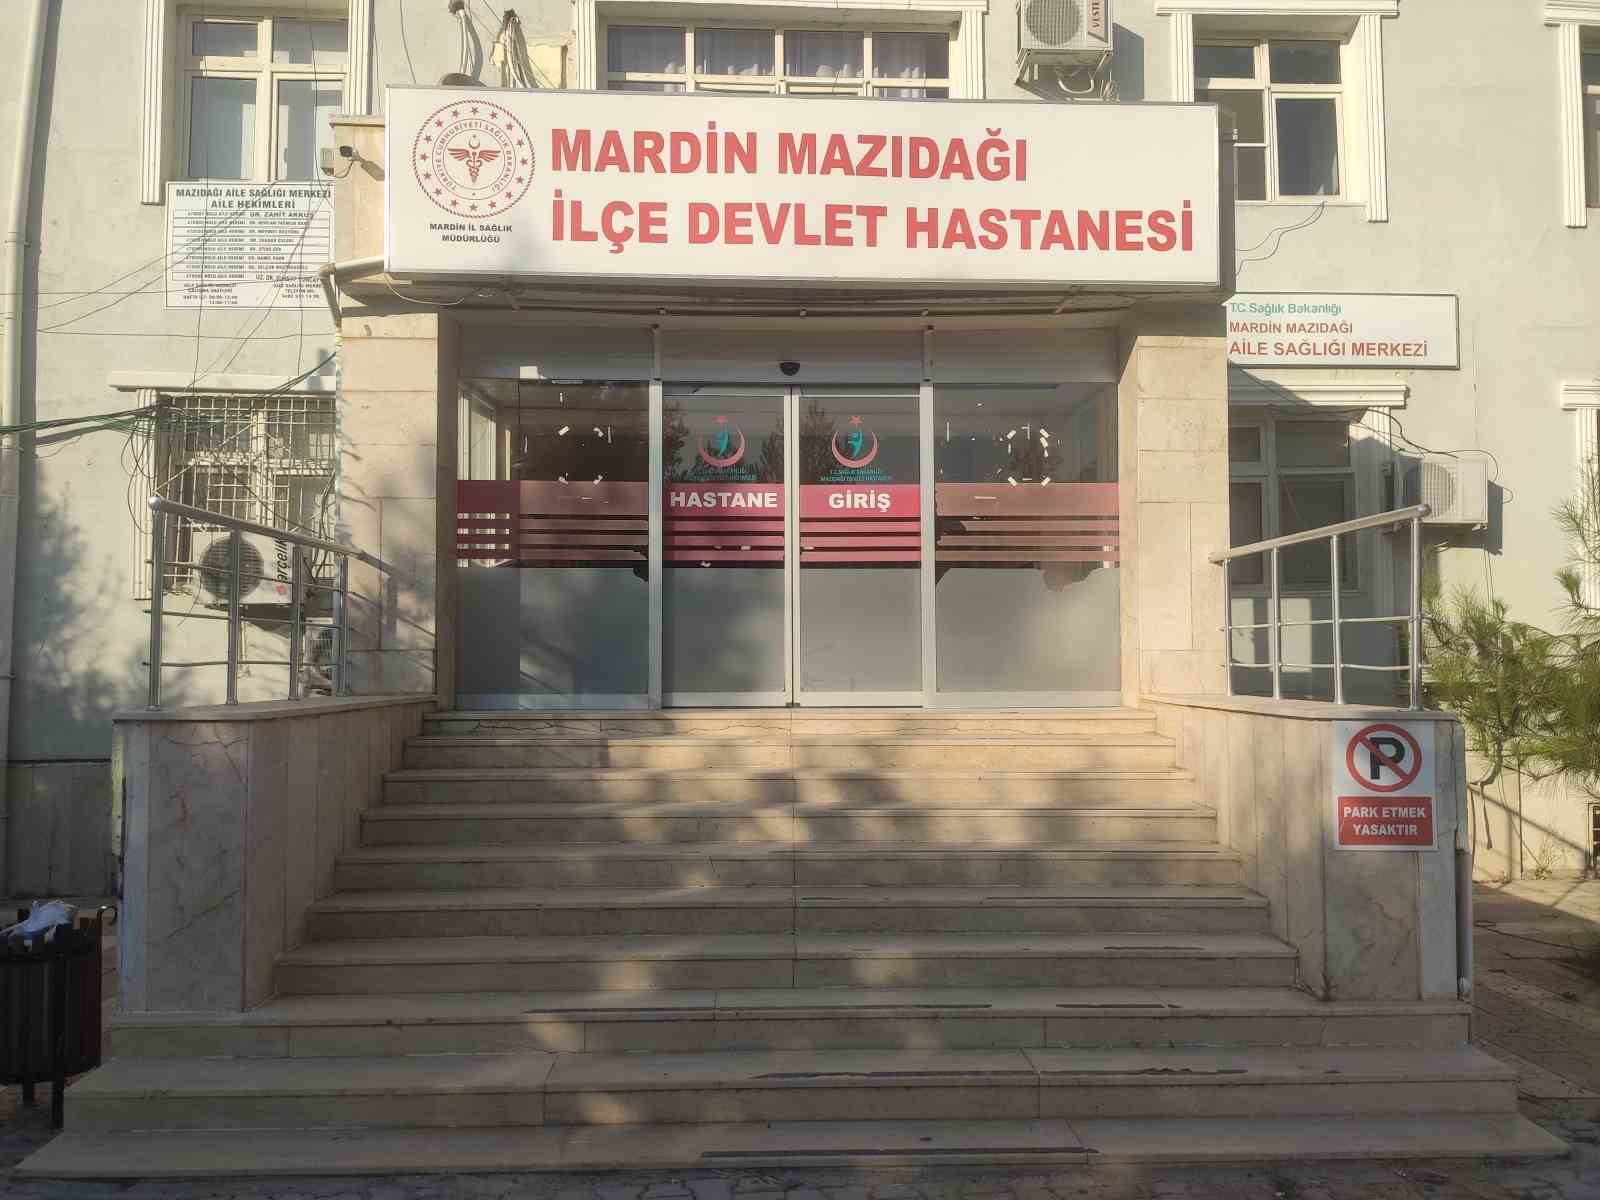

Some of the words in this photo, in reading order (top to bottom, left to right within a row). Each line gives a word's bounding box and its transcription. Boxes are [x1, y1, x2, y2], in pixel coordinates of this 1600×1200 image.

[552, 121, 757, 174] MARDİN
[778, 127, 1027, 182] MAZIDAĞI
[176, 188, 223, 198] MAZIDAĞI
[225, 188, 246, 198] AİLE
[249, 188, 286, 199] SAĞLIĞI
[210, 200, 234, 209] AİLE
[429, 223, 466, 232] MARDİN
[468, 223, 477, 232] İL
[479, 223, 512, 233] SAĞLIK
[552, 189, 667, 254] İLÇE
[688, 202, 887, 248] DEVLET
[906, 200, 1193, 252] HASTANESİ
[441, 233, 501, 244] MÜDÜRLÜĞÜ
[1249, 303, 1285, 316] Sağlık
[1288, 303, 1342, 316] Bakanlığı
[1229, 320, 1281, 334] MARDİN
[1286, 321, 1353, 334] MAZIDAĞI
[1229, 339, 1268, 356] AİLE
[1273, 339, 1346, 357] SAĞLIĞI
[1351, 340, 1428, 357] MERKEZİ
[670, 492, 778, 508] HASTANE
[828, 489, 891, 513] GİRİŞ
[1343, 806, 1378, 818] PARK
[1382, 807, 1426, 818] ETMEK
[1353, 824, 1418, 835] YASAKTIR
